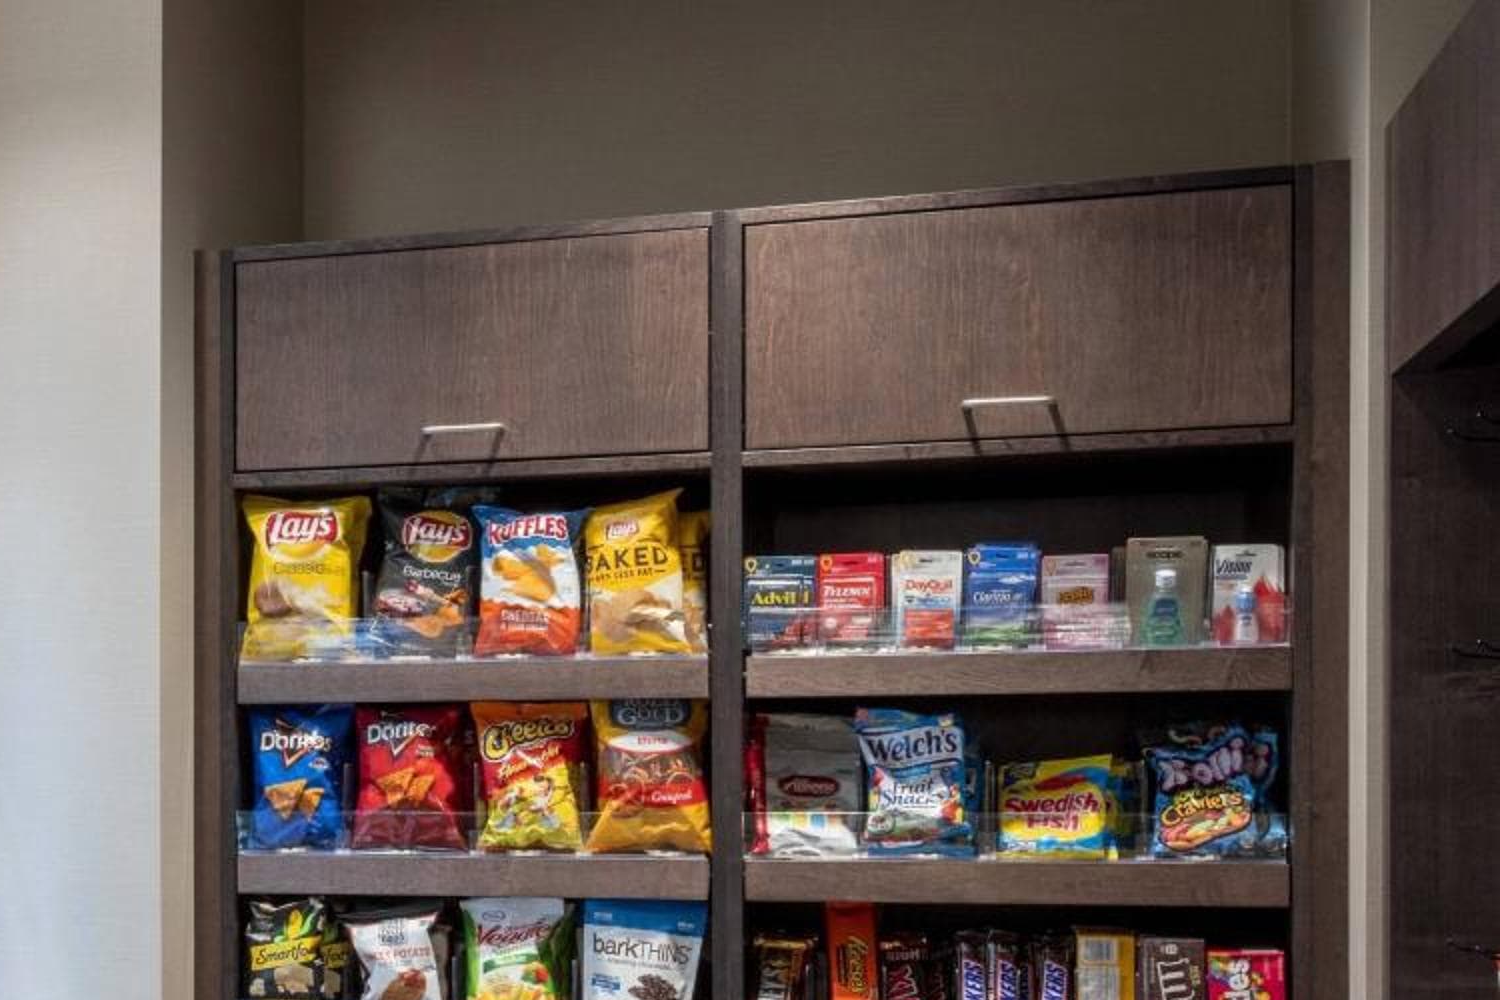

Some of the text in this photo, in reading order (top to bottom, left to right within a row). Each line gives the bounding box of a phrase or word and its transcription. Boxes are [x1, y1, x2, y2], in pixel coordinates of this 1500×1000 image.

[488, 515, 568, 545] RUFFLES
[752, 591, 796, 606] Advil
[868, 731, 958, 762] Welch's
[1005, 792, 1098, 813] Swedish
